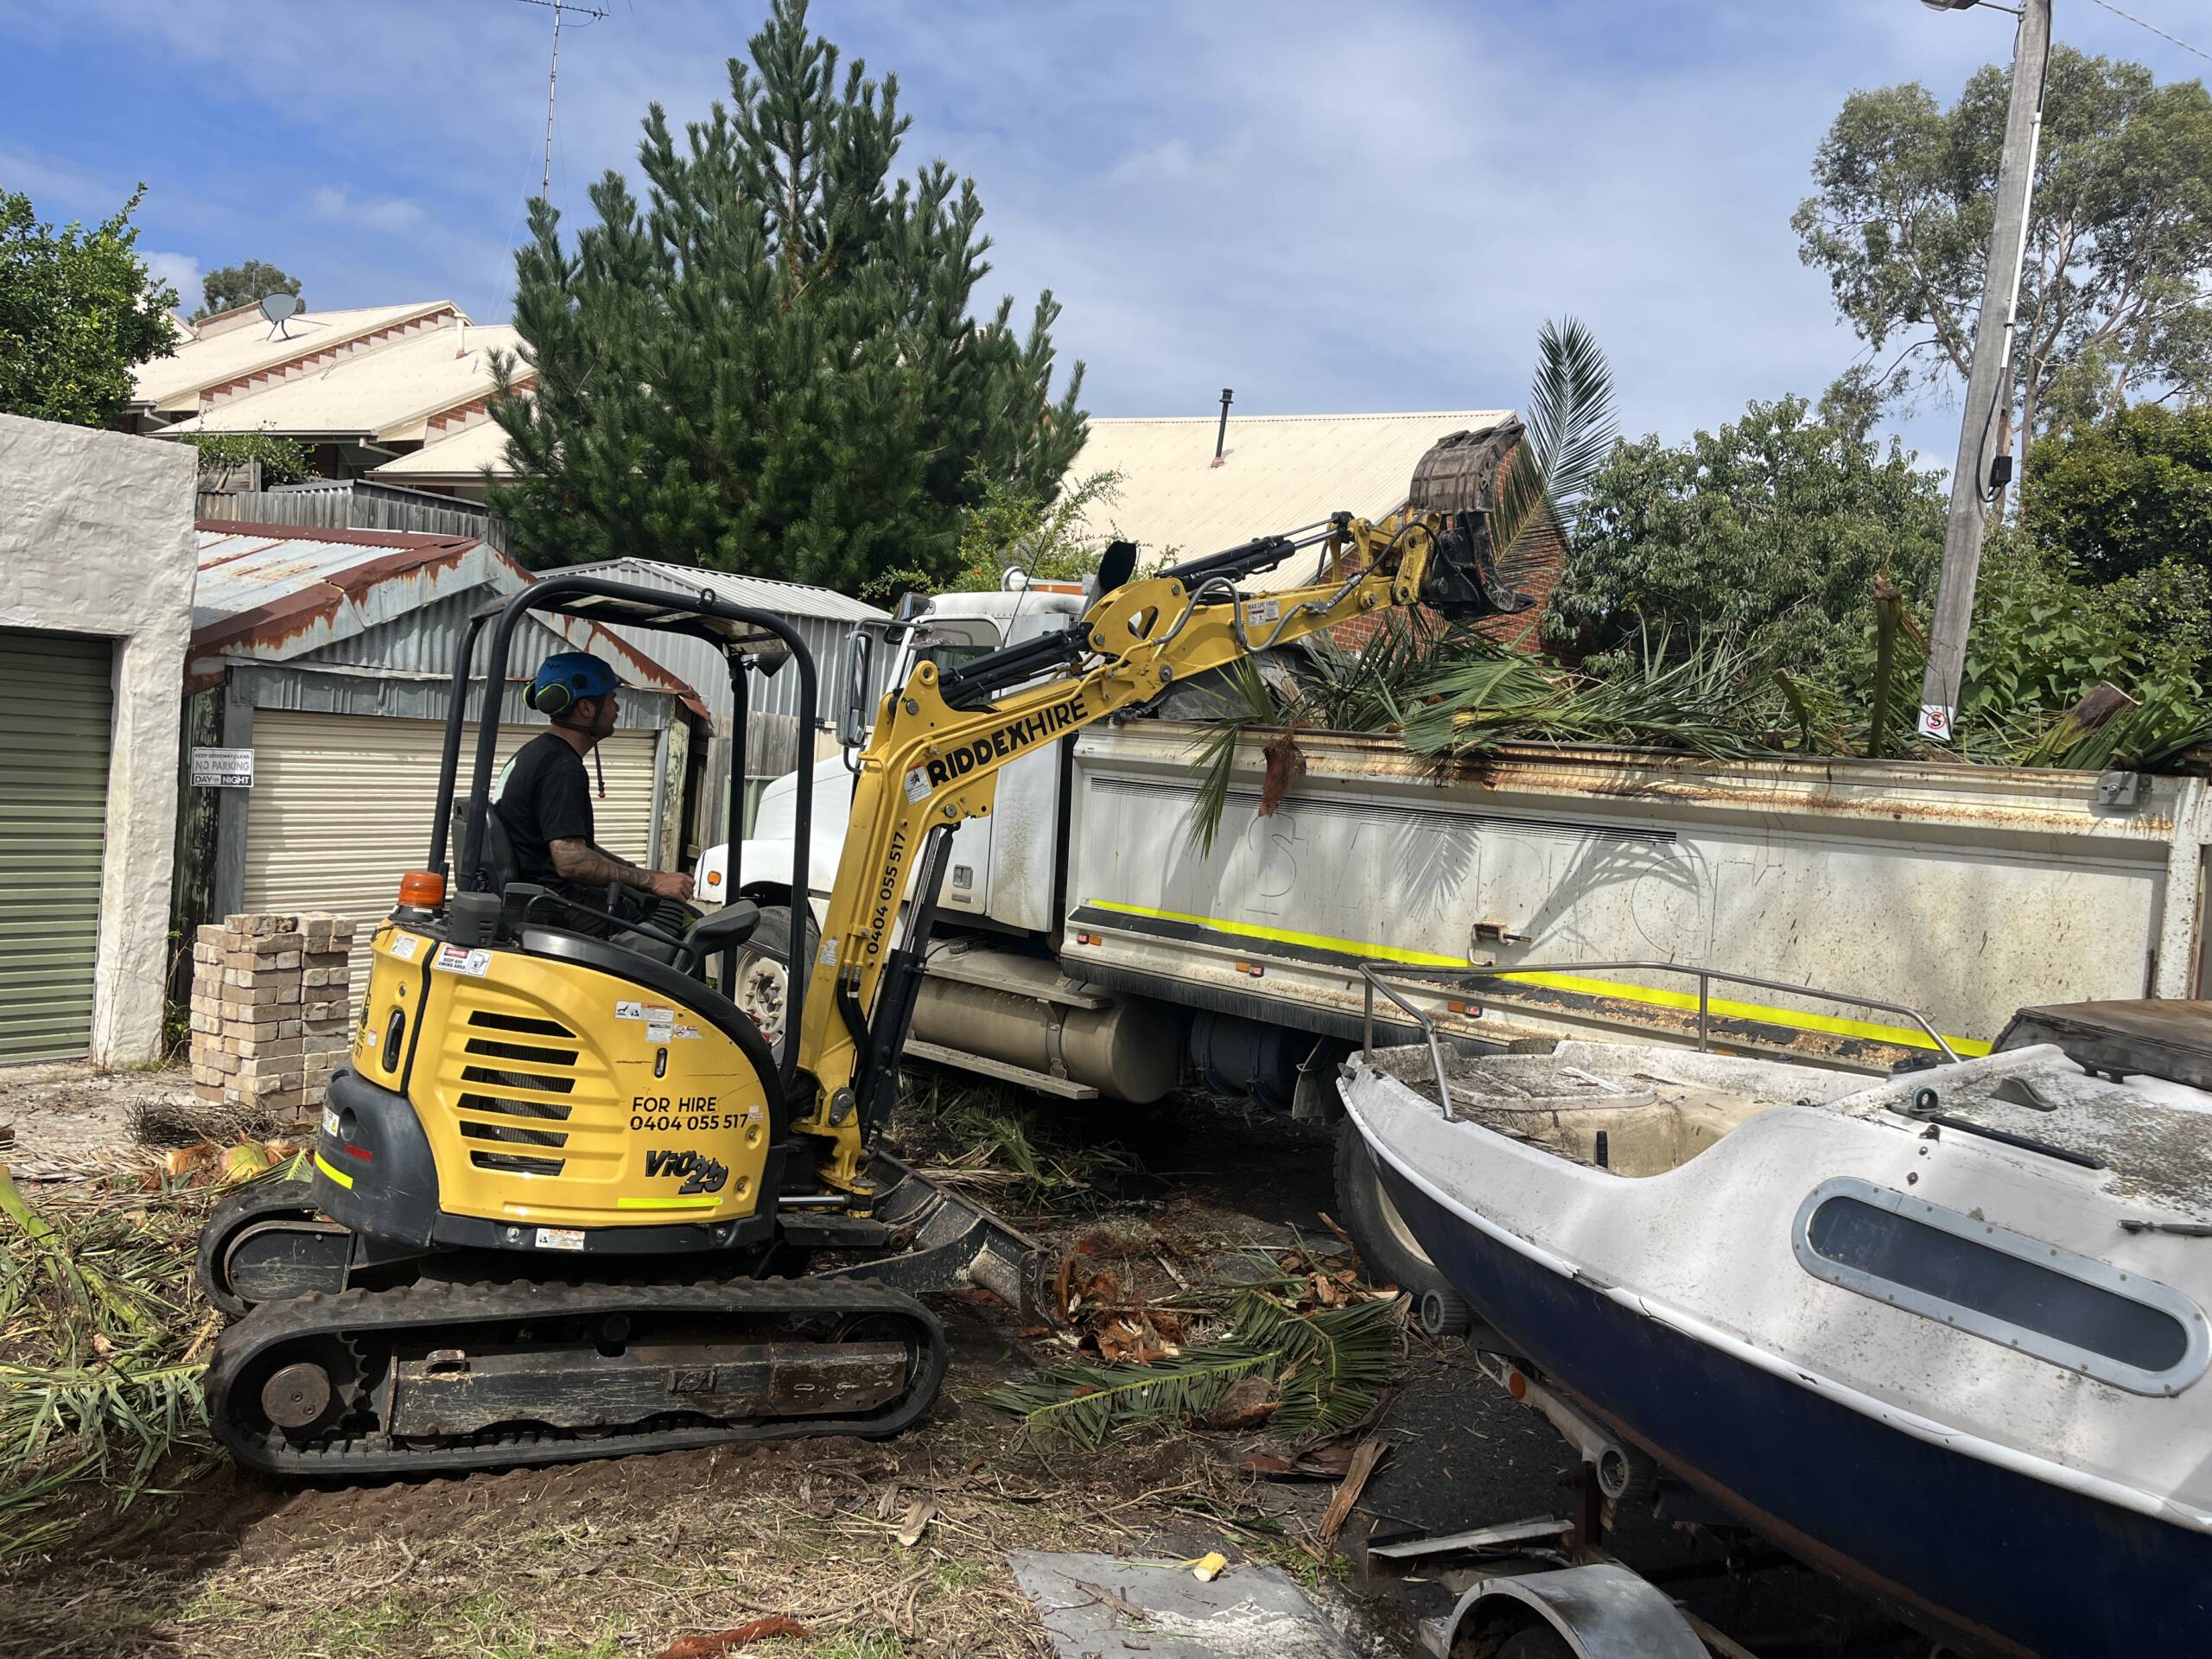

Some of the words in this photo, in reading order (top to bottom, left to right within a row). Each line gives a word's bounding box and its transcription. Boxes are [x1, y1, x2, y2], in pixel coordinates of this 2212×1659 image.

[195, 760, 209, 770] NO
[212, 761, 250, 771] PARKING
[888, 831, 906, 863] 517
[880, 864, 899, 900] 055
[867, 904, 889, 955] 0404
[632, 1096, 671, 1113] FOR
[678, 1096, 717, 1113] HIRE
[630, 1116, 683, 1131] 0404
[687, 1116, 719, 1131] 055
[723, 1113, 749, 1129] 517
